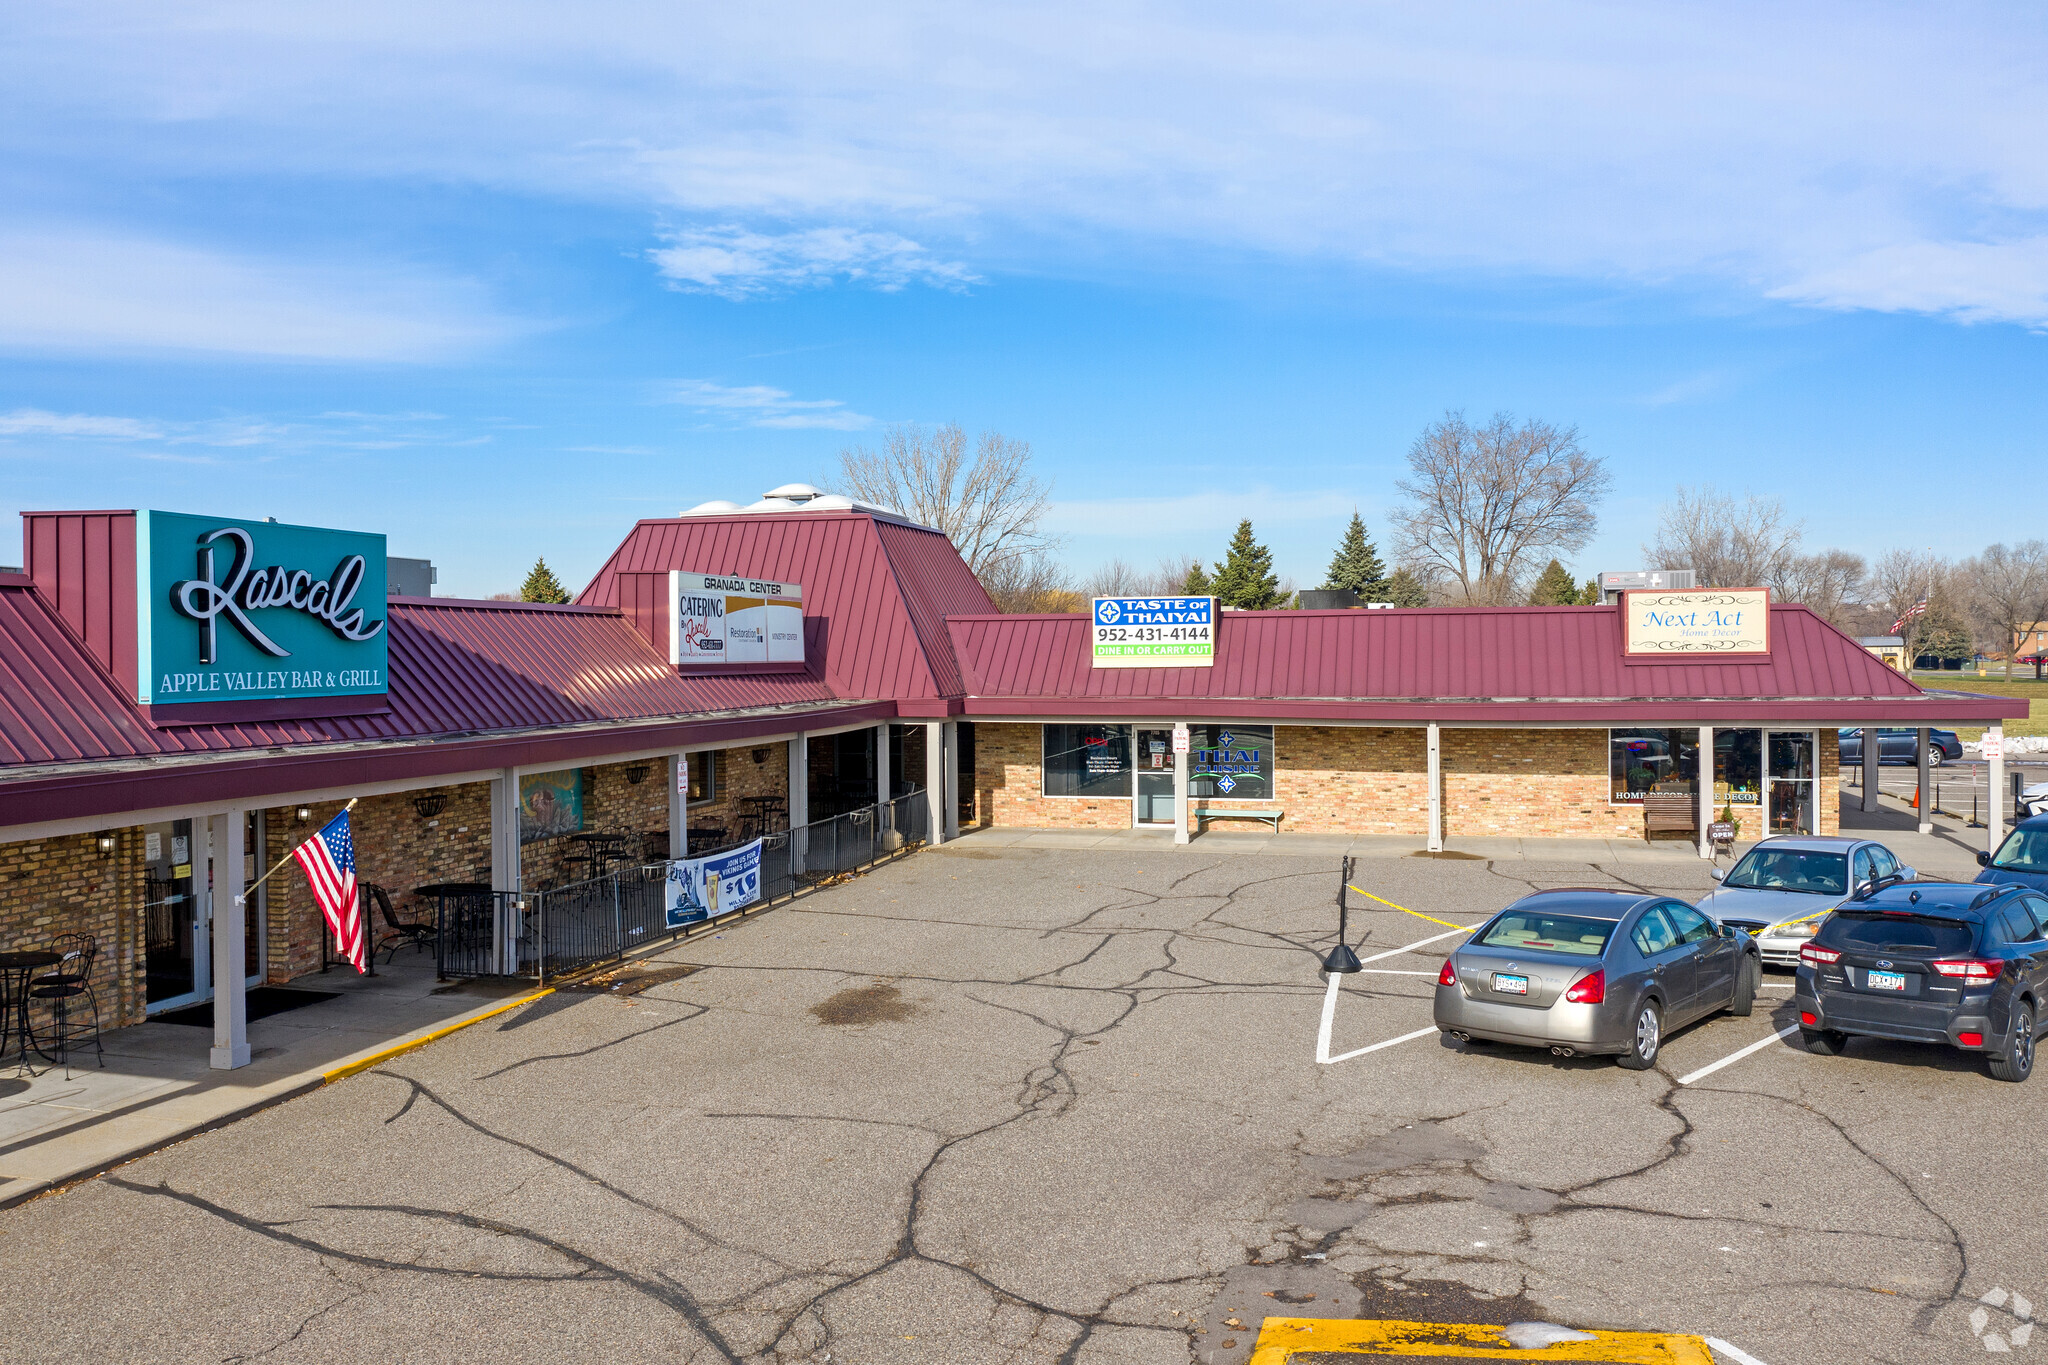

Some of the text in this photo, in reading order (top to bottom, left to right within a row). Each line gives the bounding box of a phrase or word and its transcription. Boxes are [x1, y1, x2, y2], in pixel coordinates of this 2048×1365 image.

[704, 577, 782, 595] GRANADA CENTER
[170, 527, 385, 665] Rascals
[680, 595, 723, 618] CATERING
[1122, 600, 1208, 610] TASTE OF
[1123, 612, 1207, 623] THAIYAI
[1642, 610, 1744, 627] Next Act
[681, 619, 687, 630] By
[730, 627, 757, 639] Restoration
[1098, 627, 1210, 641] 952-431-4144
[1680, 628, 1709, 637] Home
[1098, 645, 1210, 655] DINE IN OR CARRY OUT
[159, 669, 382, 693] APPLE VALLEY BAR & GRILL
[1085, 736, 1108, 747] OPEN
[1193, 749, 1260, 763] THAI
[1195, 764, 1261, 773] CUISINE
[1724, 793, 1759, 801] DECOR
[726, 850, 756, 868] JOIN US FOR
[721, 863, 743, 876] VIKINGS
[1513, 980, 1526, 989] 496
[1889, 976, 1902, 986] 171
